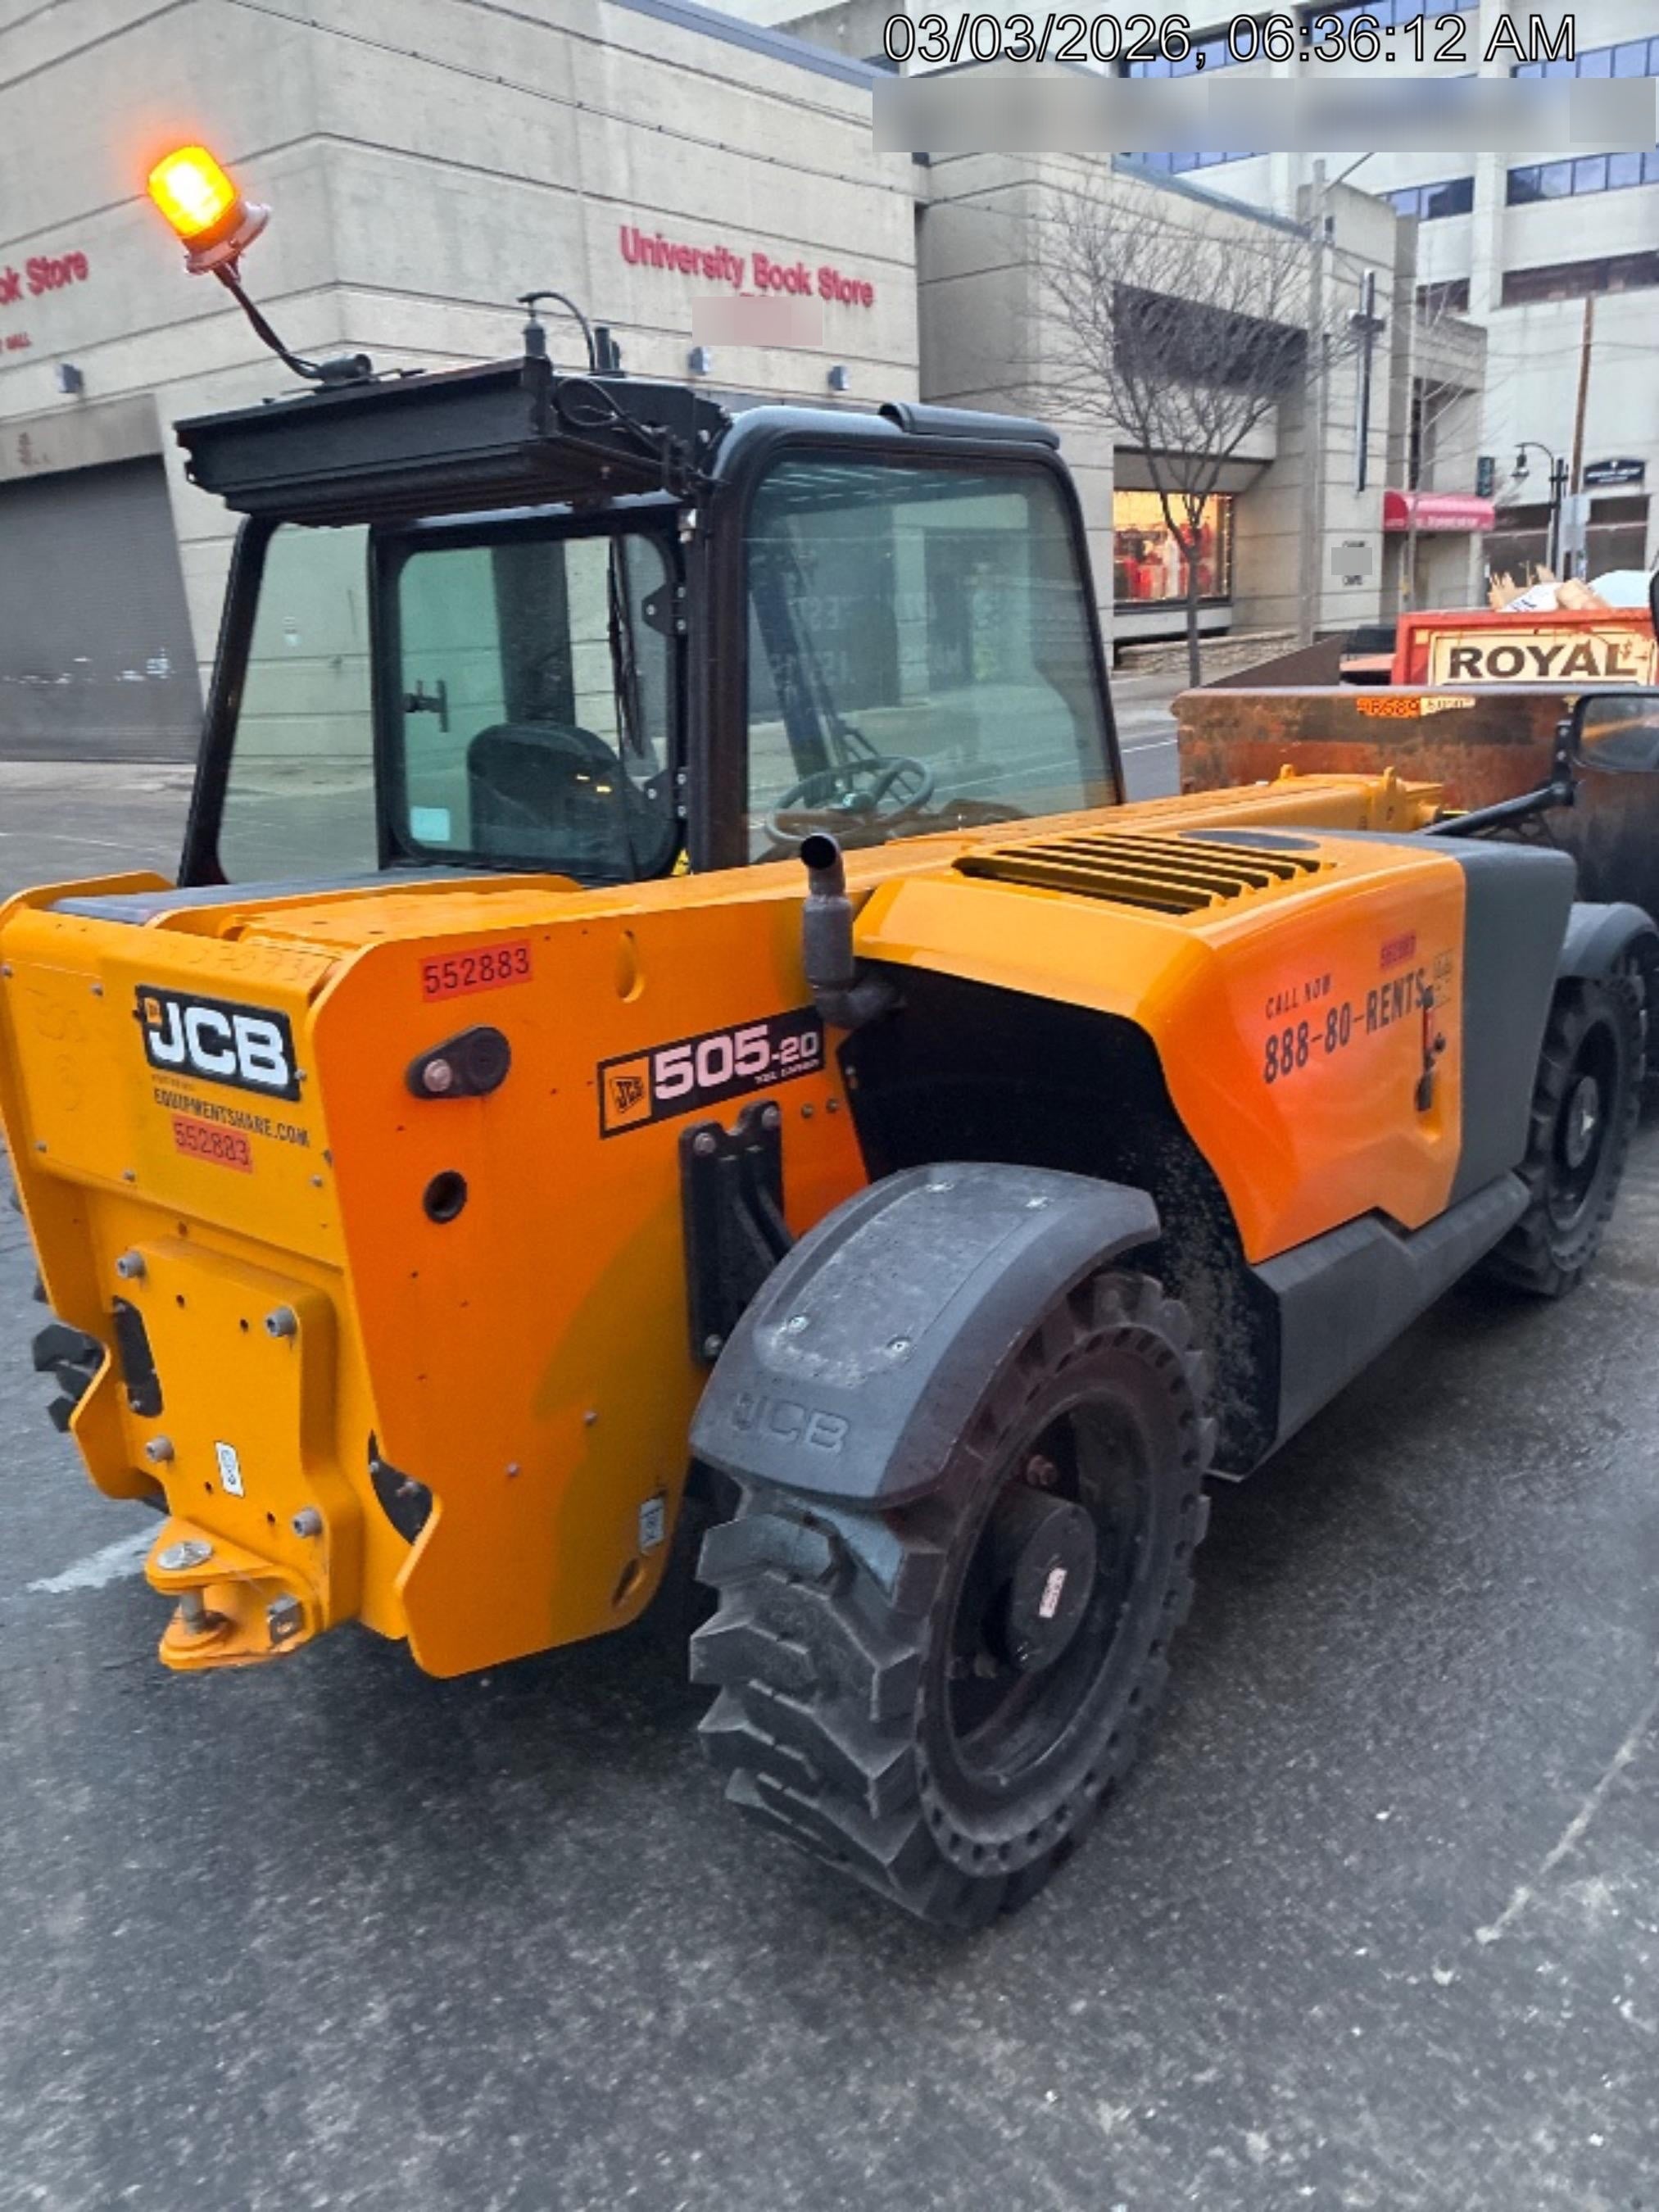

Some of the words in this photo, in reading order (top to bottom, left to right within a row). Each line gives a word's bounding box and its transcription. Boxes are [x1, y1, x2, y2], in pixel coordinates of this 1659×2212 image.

[26, 251, 88, 296] Store
[619, 225, 745, 290] University
[751, 252, 813, 296] Book
[818, 265, 874, 308] Store
[1448, 641, 1638, 679] ROYAL
[424, 948, 528, 993] 552883
[1266, 987, 1299, 1020] CALL
[1305, 972, 1331, 1001] NOW
[148, 1000, 289, 1086] JCB
[1263, 967, 1428, 1084] 888-80-RENTS
[654, 1024, 818, 1100] 505-20
[153, 1087, 310, 1147] EQUIPMENTSHARE.COM
[174, 1122, 250, 1158] 552883
[733, 1392, 850, 1455] JCB
